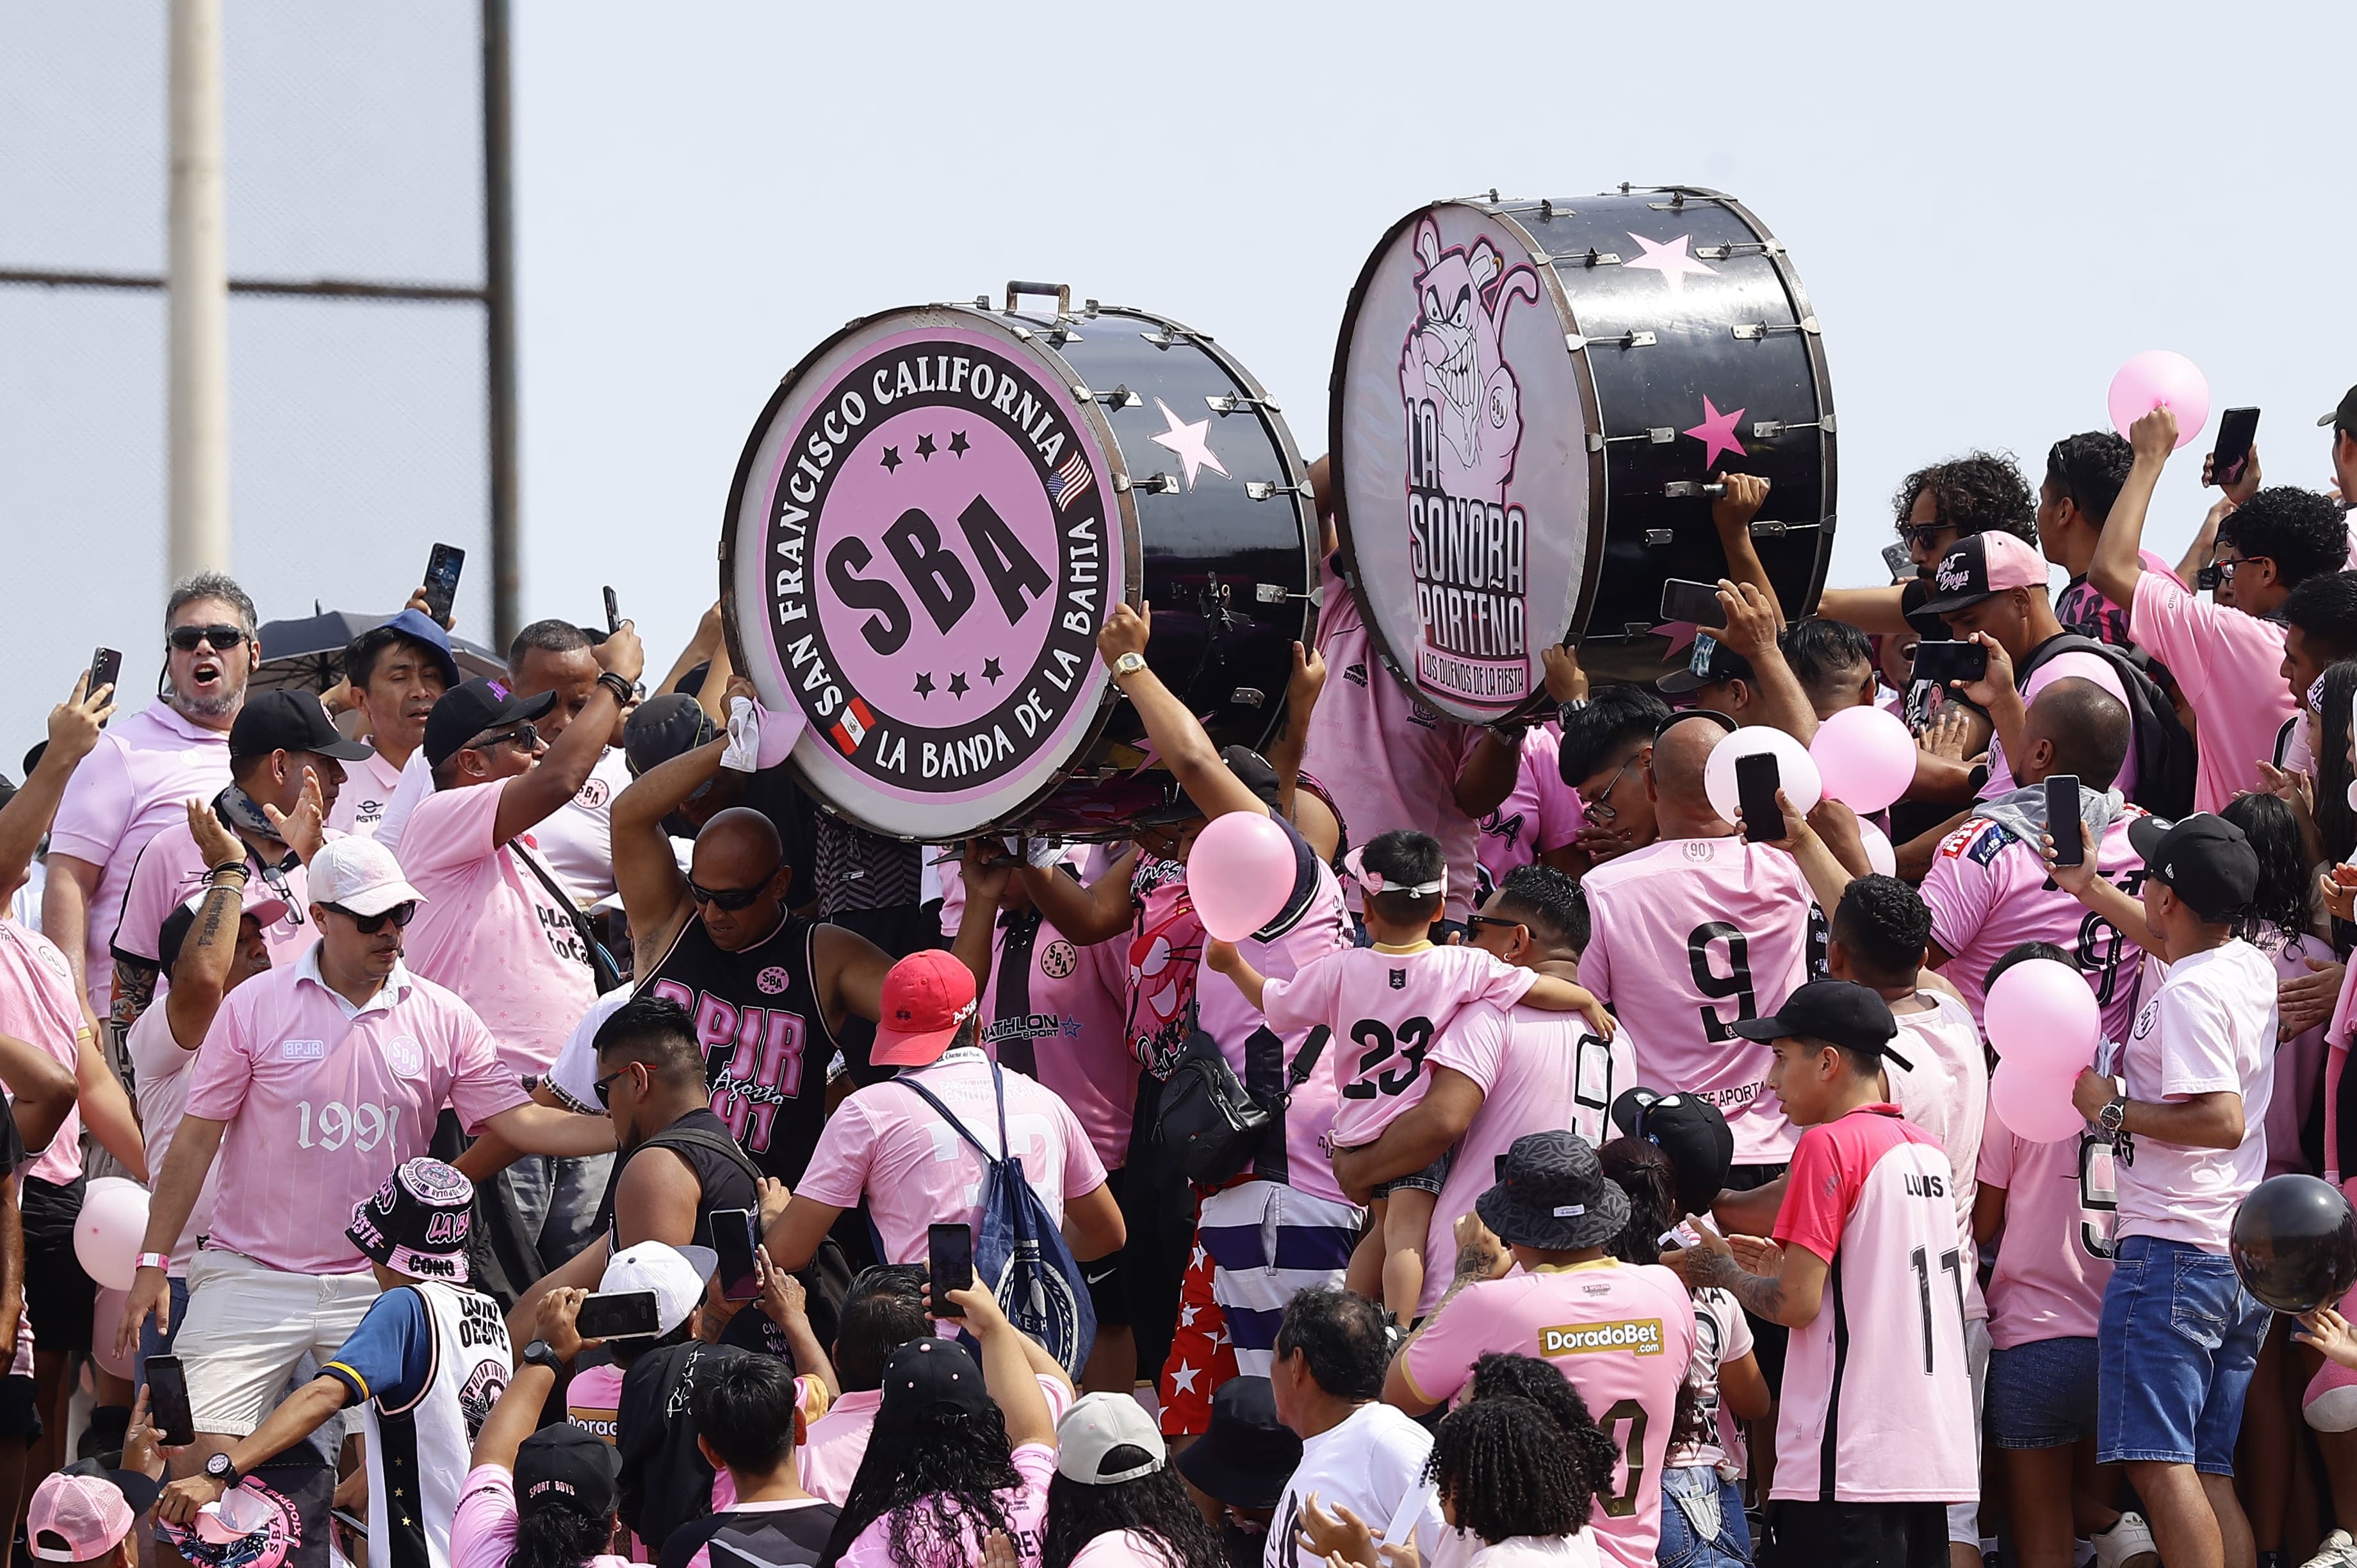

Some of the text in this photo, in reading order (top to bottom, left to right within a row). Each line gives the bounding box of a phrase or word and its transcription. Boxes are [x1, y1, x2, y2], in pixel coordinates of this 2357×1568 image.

[1407, 398, 1440, 490] LA
[776, 354, 1067, 717] SAN FRANCISCO CALIFORNIA
[1409, 493, 1525, 594] SONORA
[824, 493, 1054, 656] SBA
[876, 516, 1098, 778] LA BANDA DE LA BAHIA
[1422, 650, 1524, 696] LOS DUEÑOS DE LA FIESTA
[1690, 842, 1706, 856] 90
[1048, 944, 1068, 975] SBA
[762, 971, 783, 990] SBA
[1686, 920, 1757, 1043] 9
[284, 1042, 322, 1057] BPJR
[1022, 1028, 1059, 1040] SPORT
[391, 1041, 419, 1070] SBA
[1342, 1015, 1435, 1100] 23
[712, 1066, 785, 1105] Agosto
[295, 1100, 400, 1152] 1991
[1904, 1173, 1944, 1198] LUIS
[427, 1213, 455, 1243] LA
[408, 1254, 455, 1277] CONO
[1909, 1244, 1971, 1378] 11
[459, 1318, 509, 1353] OESTE
[1546, 1321, 1658, 1351] DoradoBet
[1636, 1343, 1660, 1353] .com
[529, 1480, 575, 1499] SPORT BOYS
[269, 1515, 282, 1556] SBA
